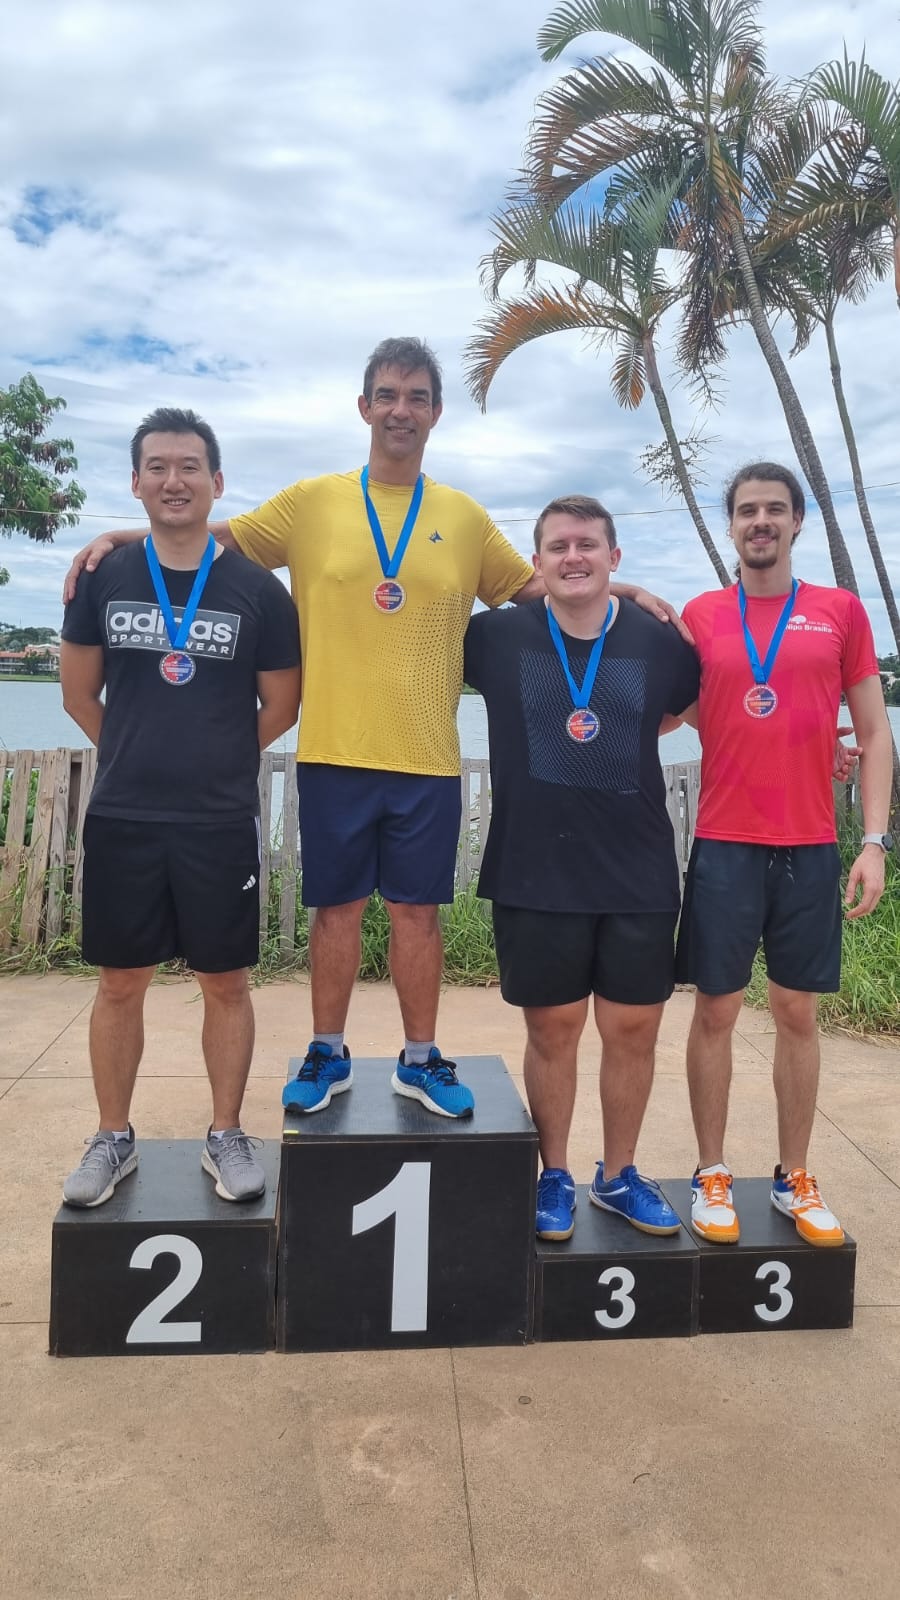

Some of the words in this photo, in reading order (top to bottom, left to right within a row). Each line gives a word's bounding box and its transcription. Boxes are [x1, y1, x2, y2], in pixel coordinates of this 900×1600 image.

[110, 608, 232, 643] adias
[111, 634, 230, 654] SPORTWEAR
[352, 1161, 432, 1333] 1
[126, 1234, 203, 1344] 2
[594, 1266, 636, 1329] 3
[754, 1260, 793, 1322] 3
